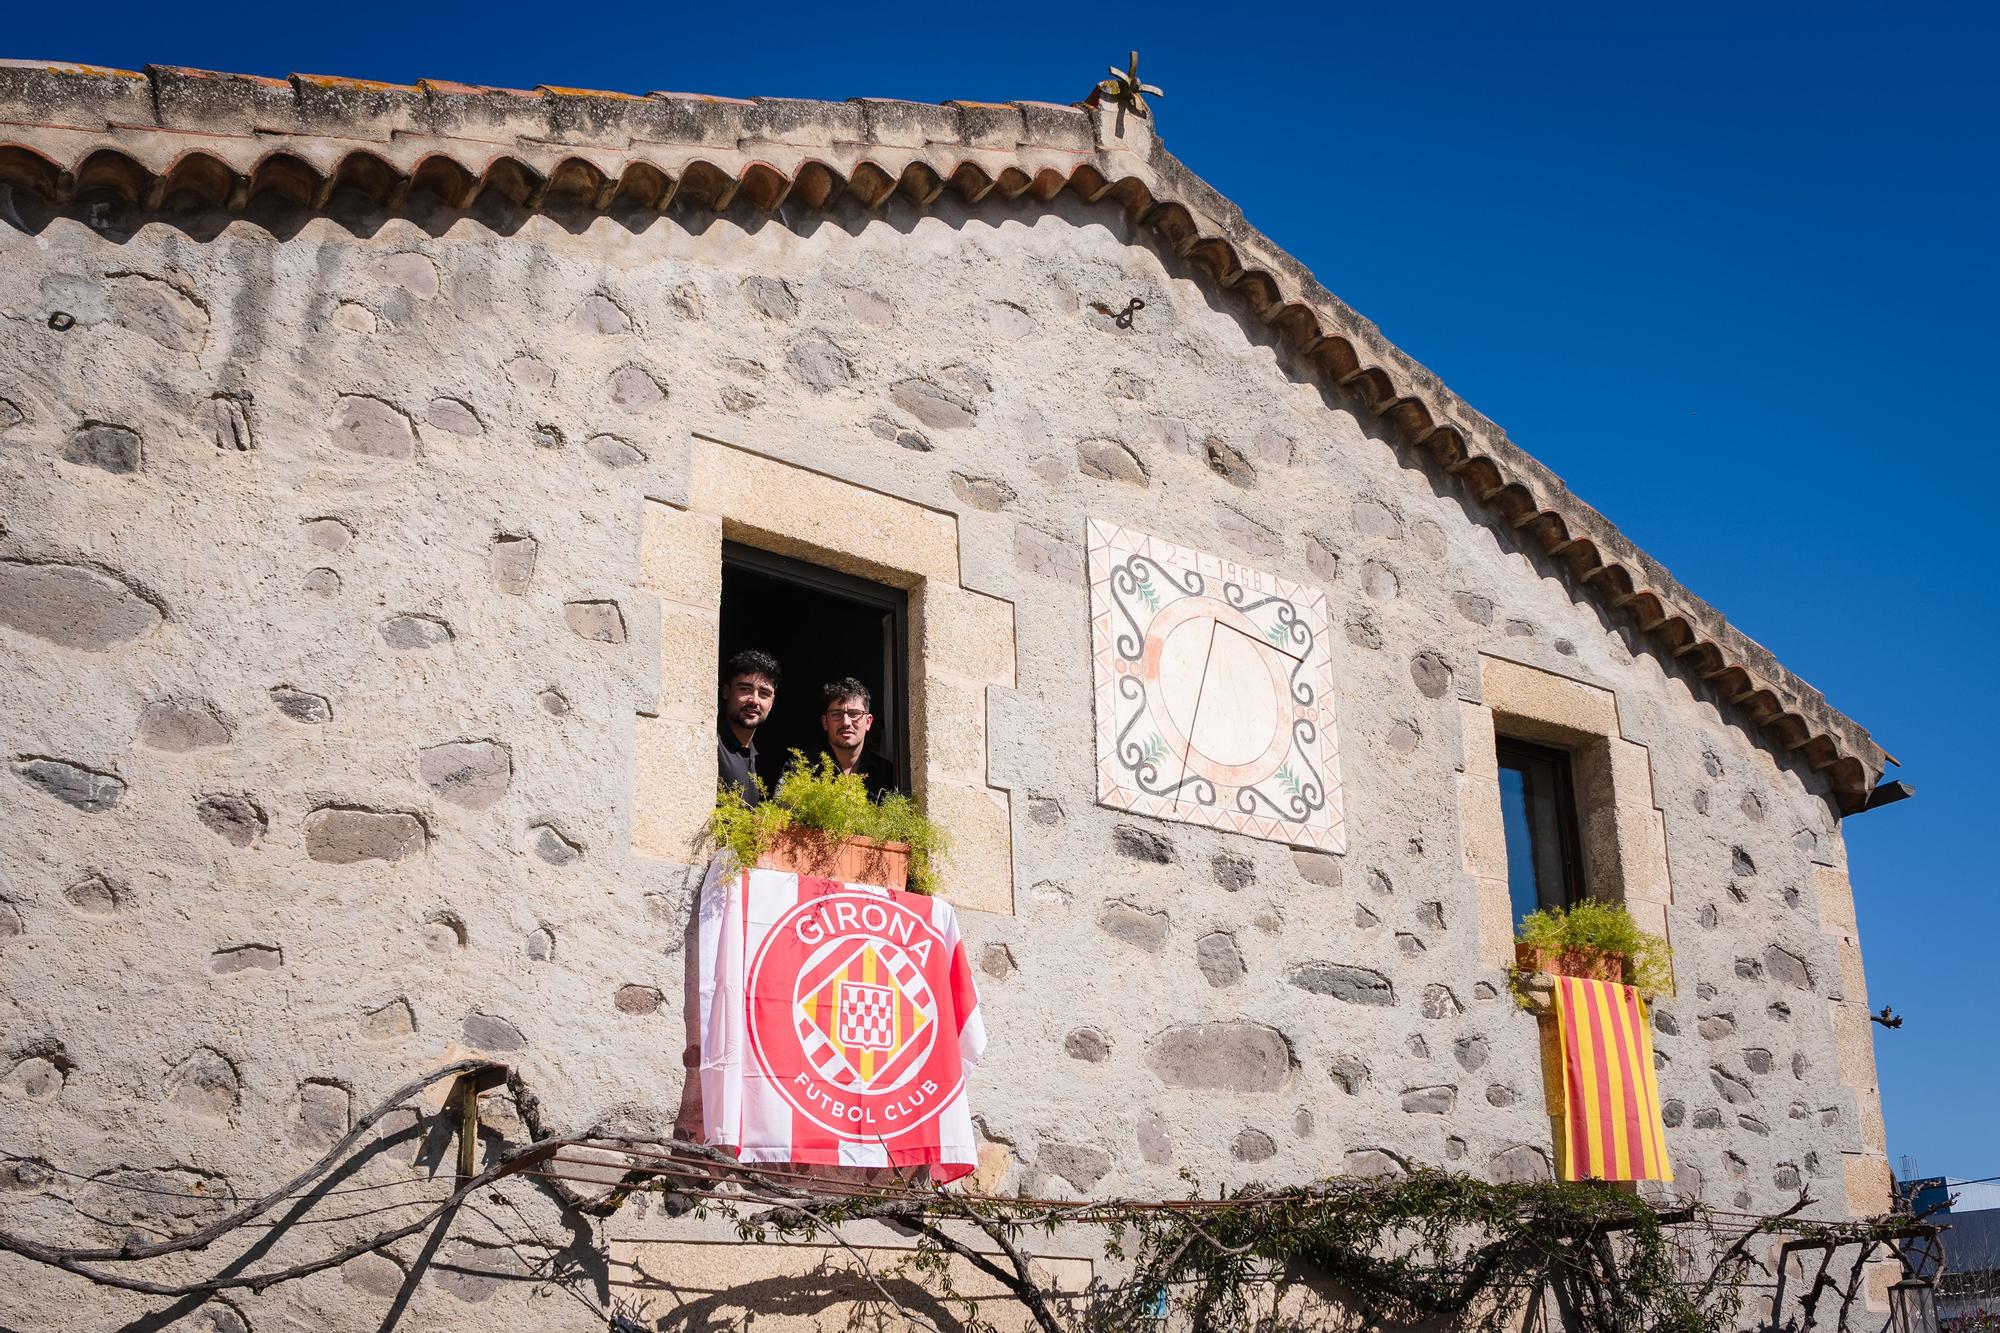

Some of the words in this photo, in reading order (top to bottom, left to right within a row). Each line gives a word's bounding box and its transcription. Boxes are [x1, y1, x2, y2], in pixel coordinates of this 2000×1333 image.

[796, 902, 932, 968] GIRONA
[794, 1071, 876, 1123] FUTBOL
[884, 1079, 939, 1120] CLUB
